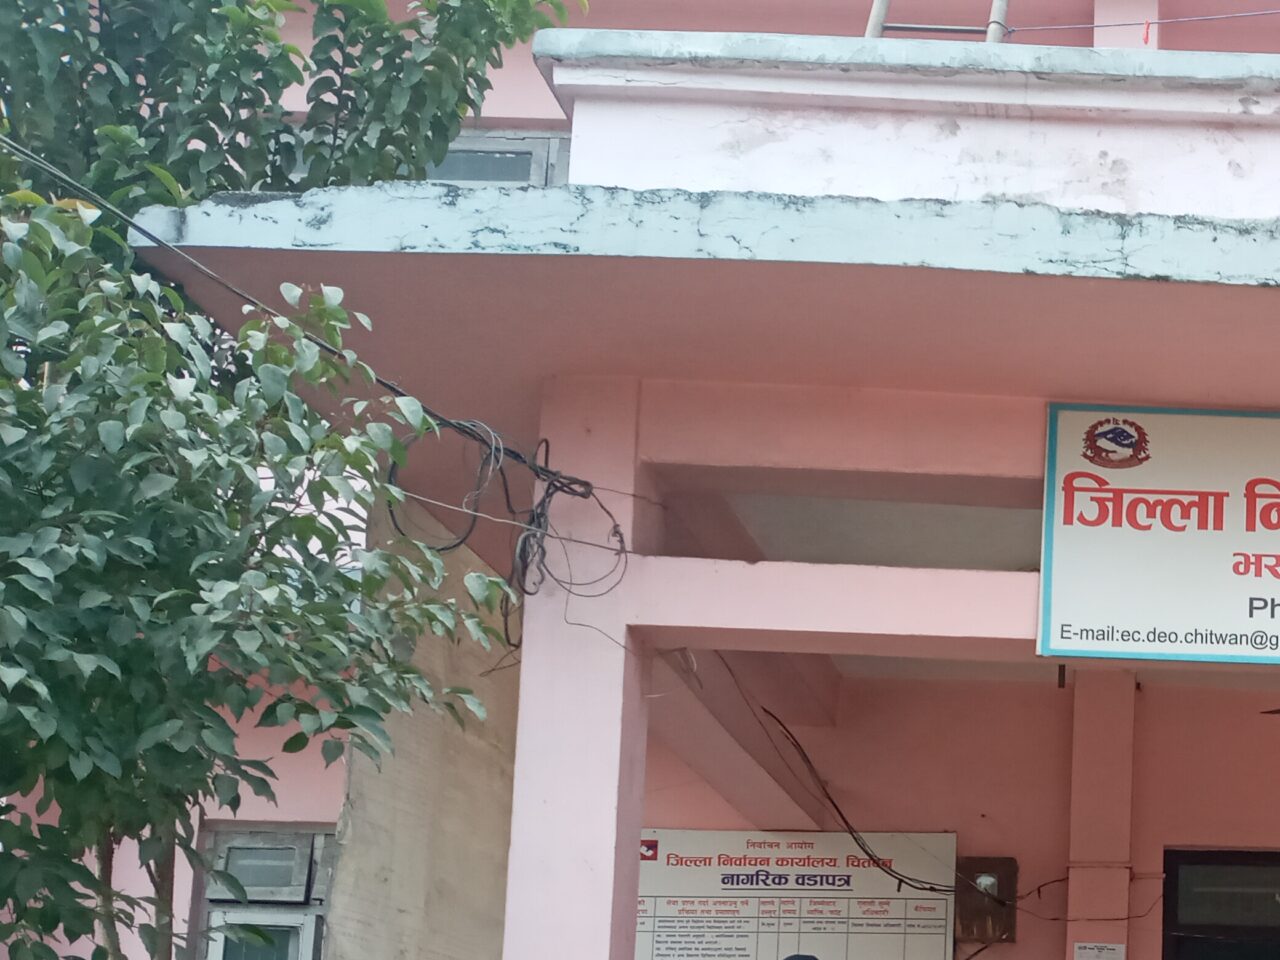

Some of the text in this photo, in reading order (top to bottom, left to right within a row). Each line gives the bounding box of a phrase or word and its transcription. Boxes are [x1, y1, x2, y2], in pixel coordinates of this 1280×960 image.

[1061, 470, 1230, 532] जिल्ला
[666, 853, 713, 868] जिल्ला
[717, 854, 772, 868] निर्वाचन
[720, 869, 853, 888] नागरिक वडापत्र
